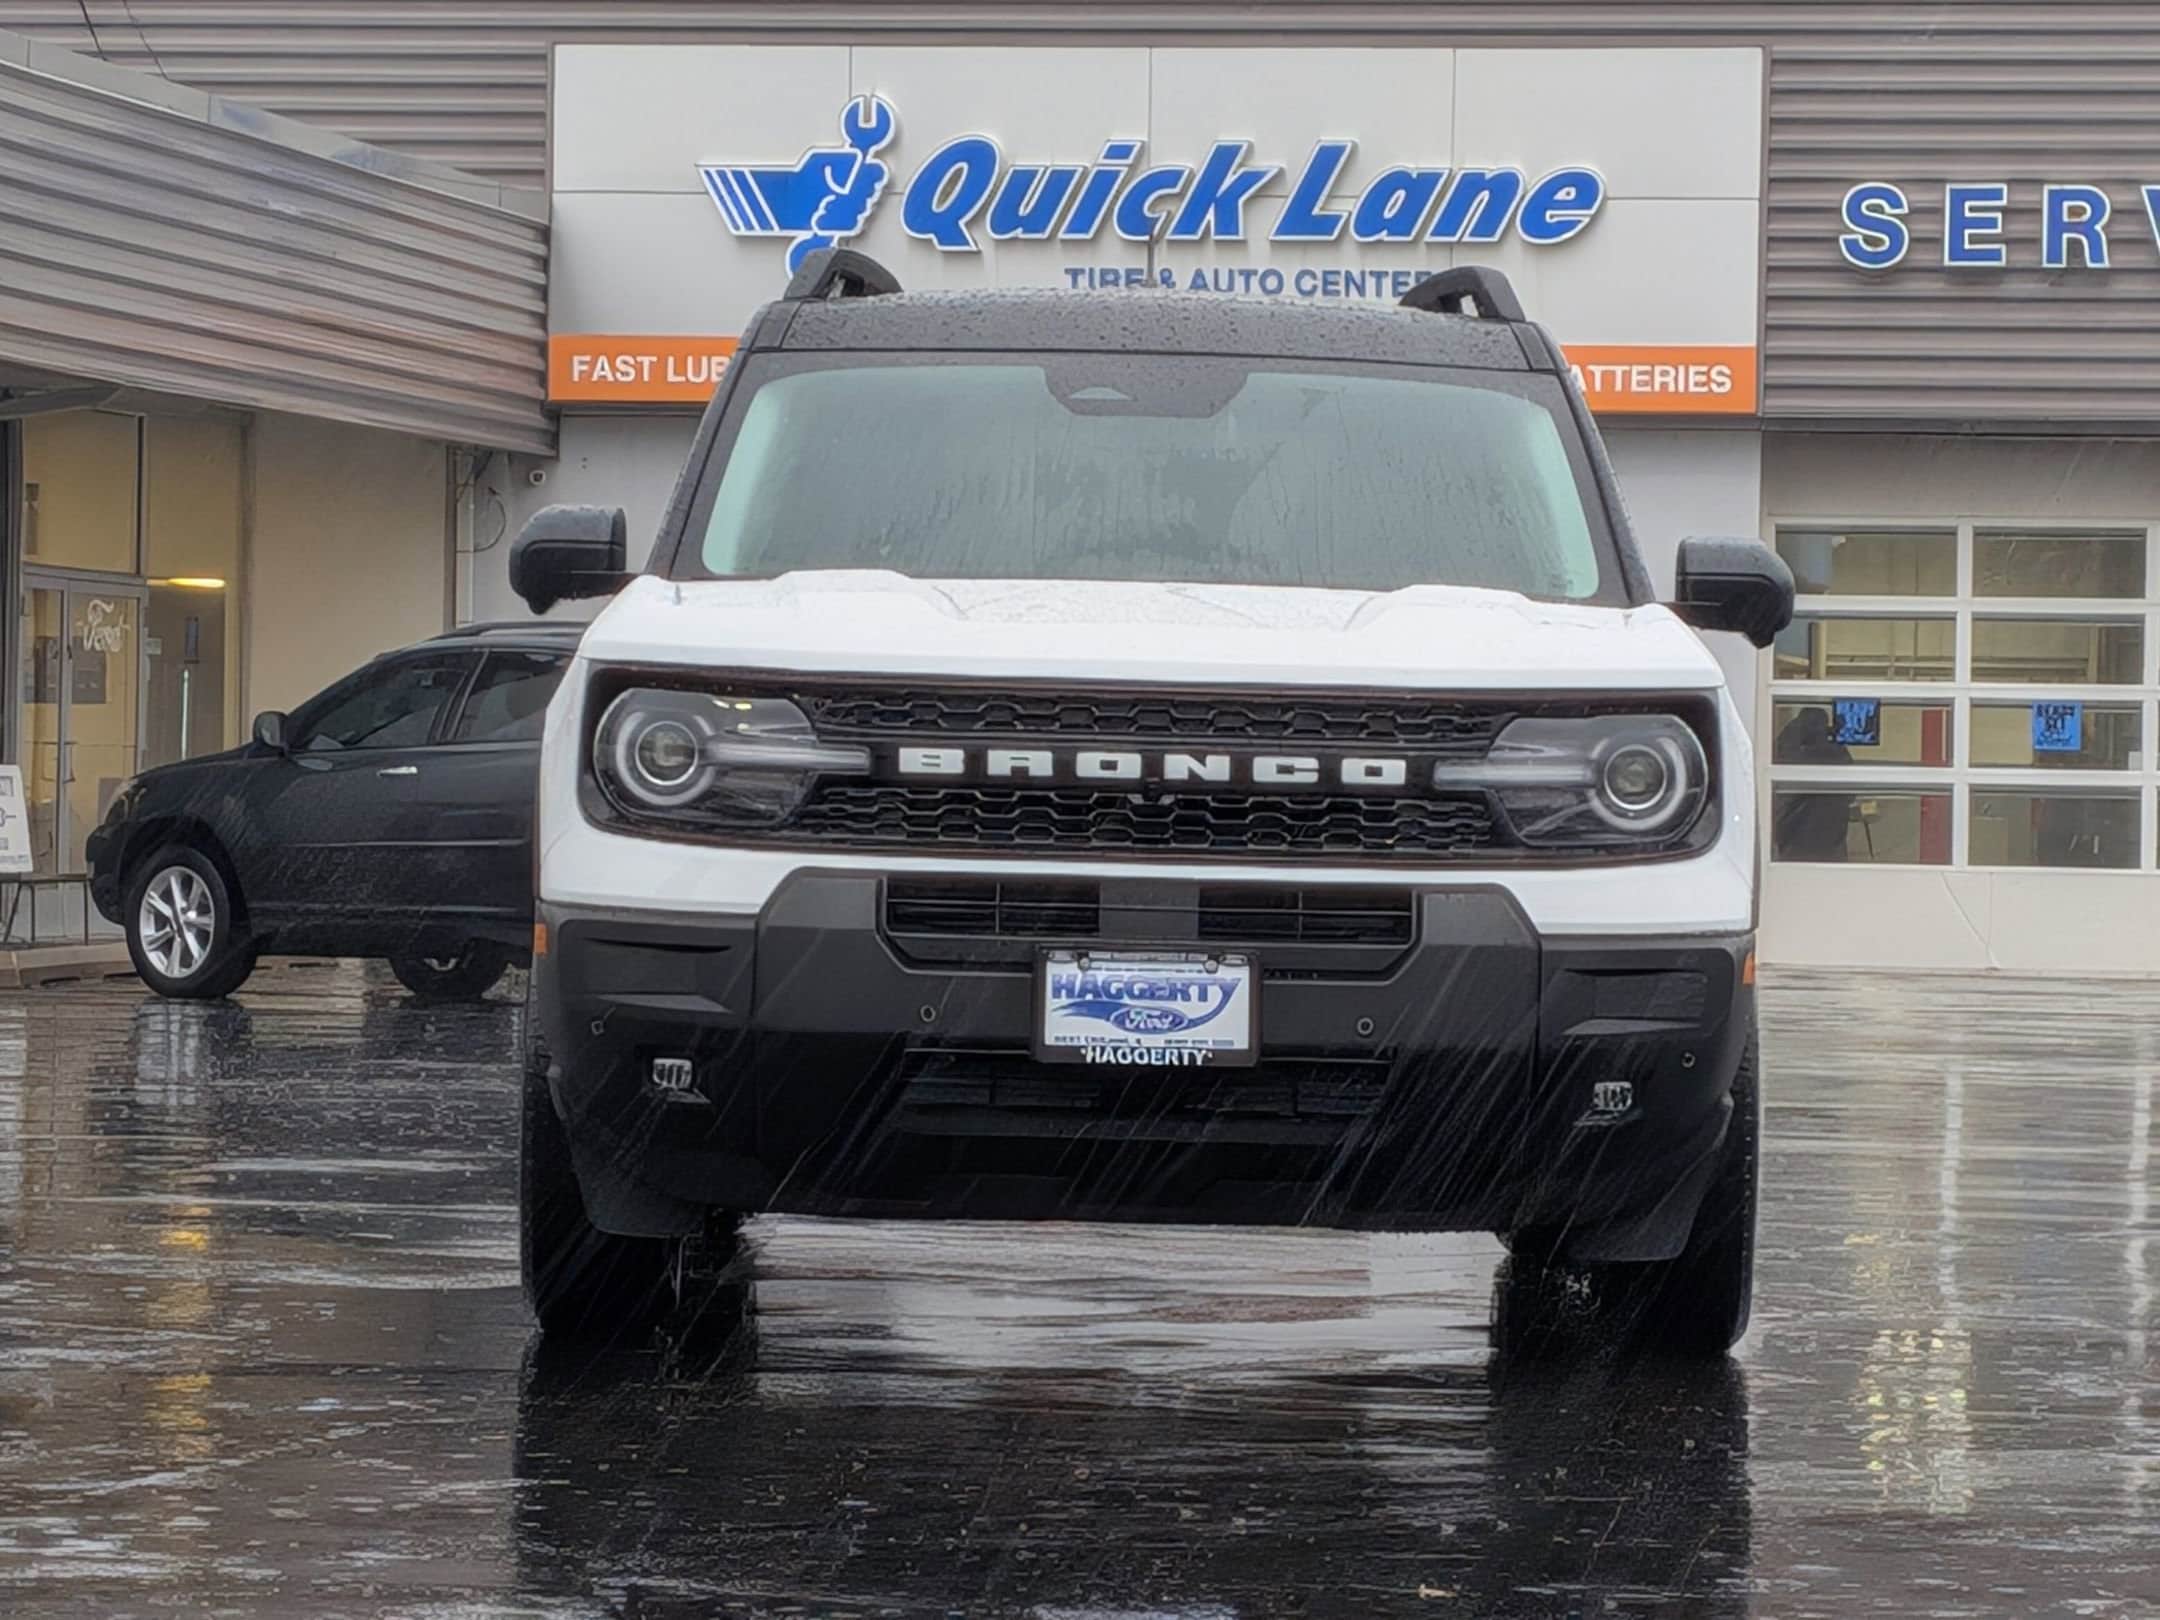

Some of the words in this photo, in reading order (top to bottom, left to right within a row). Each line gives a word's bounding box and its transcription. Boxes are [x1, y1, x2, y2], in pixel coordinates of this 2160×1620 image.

[900, 134, 1283, 252] Quick
[1268, 137, 1605, 245] Lane
[1064, 267, 1144, 289] TIRE
[1159, 267, 1177, 289] &
[1189, 267, 1284, 295] AUTO
[572, 355, 657, 382] FAST
[899, 748, 1406, 785] BRONCO
[1052, 973, 1242, 1003] HAGGERTY
[1084, 1047, 1208, 1066] HAGGERTY
